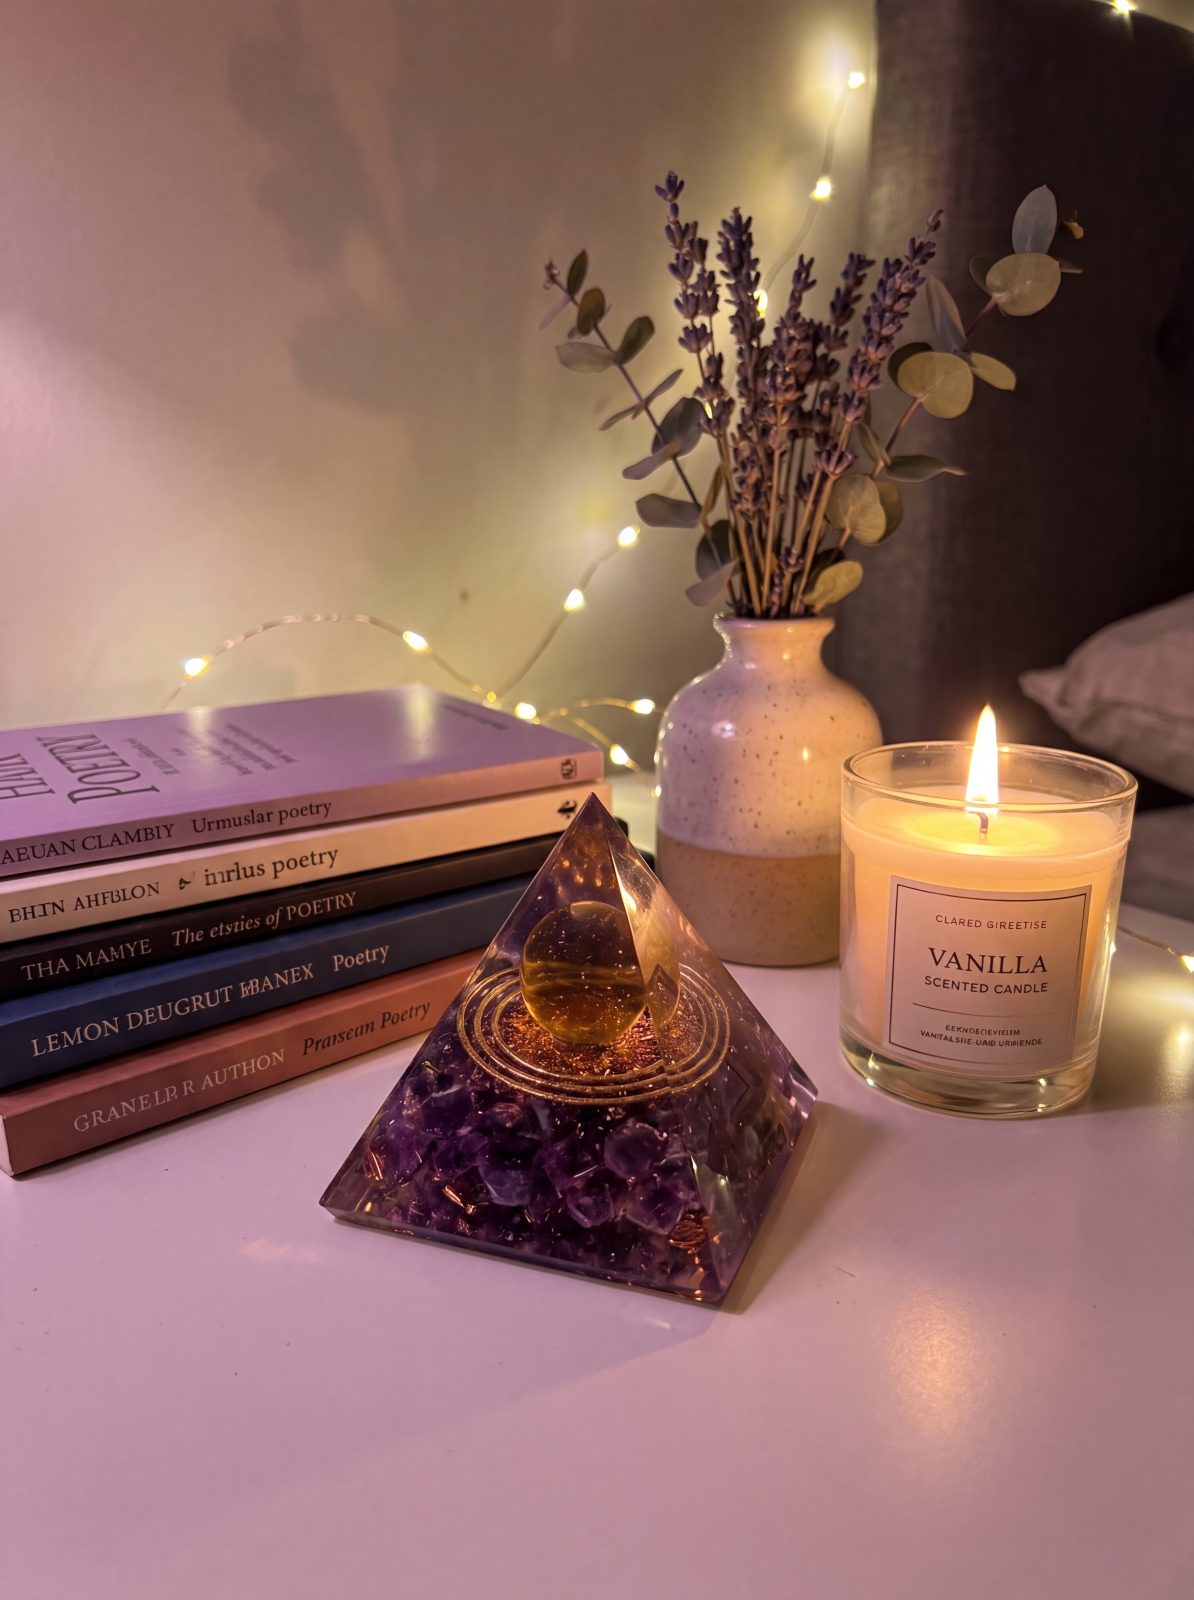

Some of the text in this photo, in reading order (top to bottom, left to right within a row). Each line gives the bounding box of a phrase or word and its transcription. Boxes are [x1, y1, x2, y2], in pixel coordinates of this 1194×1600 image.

[35, 733, 160, 804] POETRY
[192, 809, 274, 833] Urmuslar
[278, 802, 332, 825] poetry
[271, 849, 339, 879] poetry
[21, 957, 70, 981] THA
[172, 928, 204, 947] The
[265, 906, 283, 930] of
[286, 891, 357, 921] POETRY
[935, 914, 982, 929] CLARED
[928, 946, 1048, 975] VANILLA
[924, 975, 1049, 995] SCENTED CANDLE
[31, 1016, 120, 1057] LEMON
[126, 985, 233, 1031] DEUGRUT
[332, 945, 390, 973] Poetry
[201, 1048, 285, 1090] AUTHON
[380, 1002, 431, 1029] Poetry
